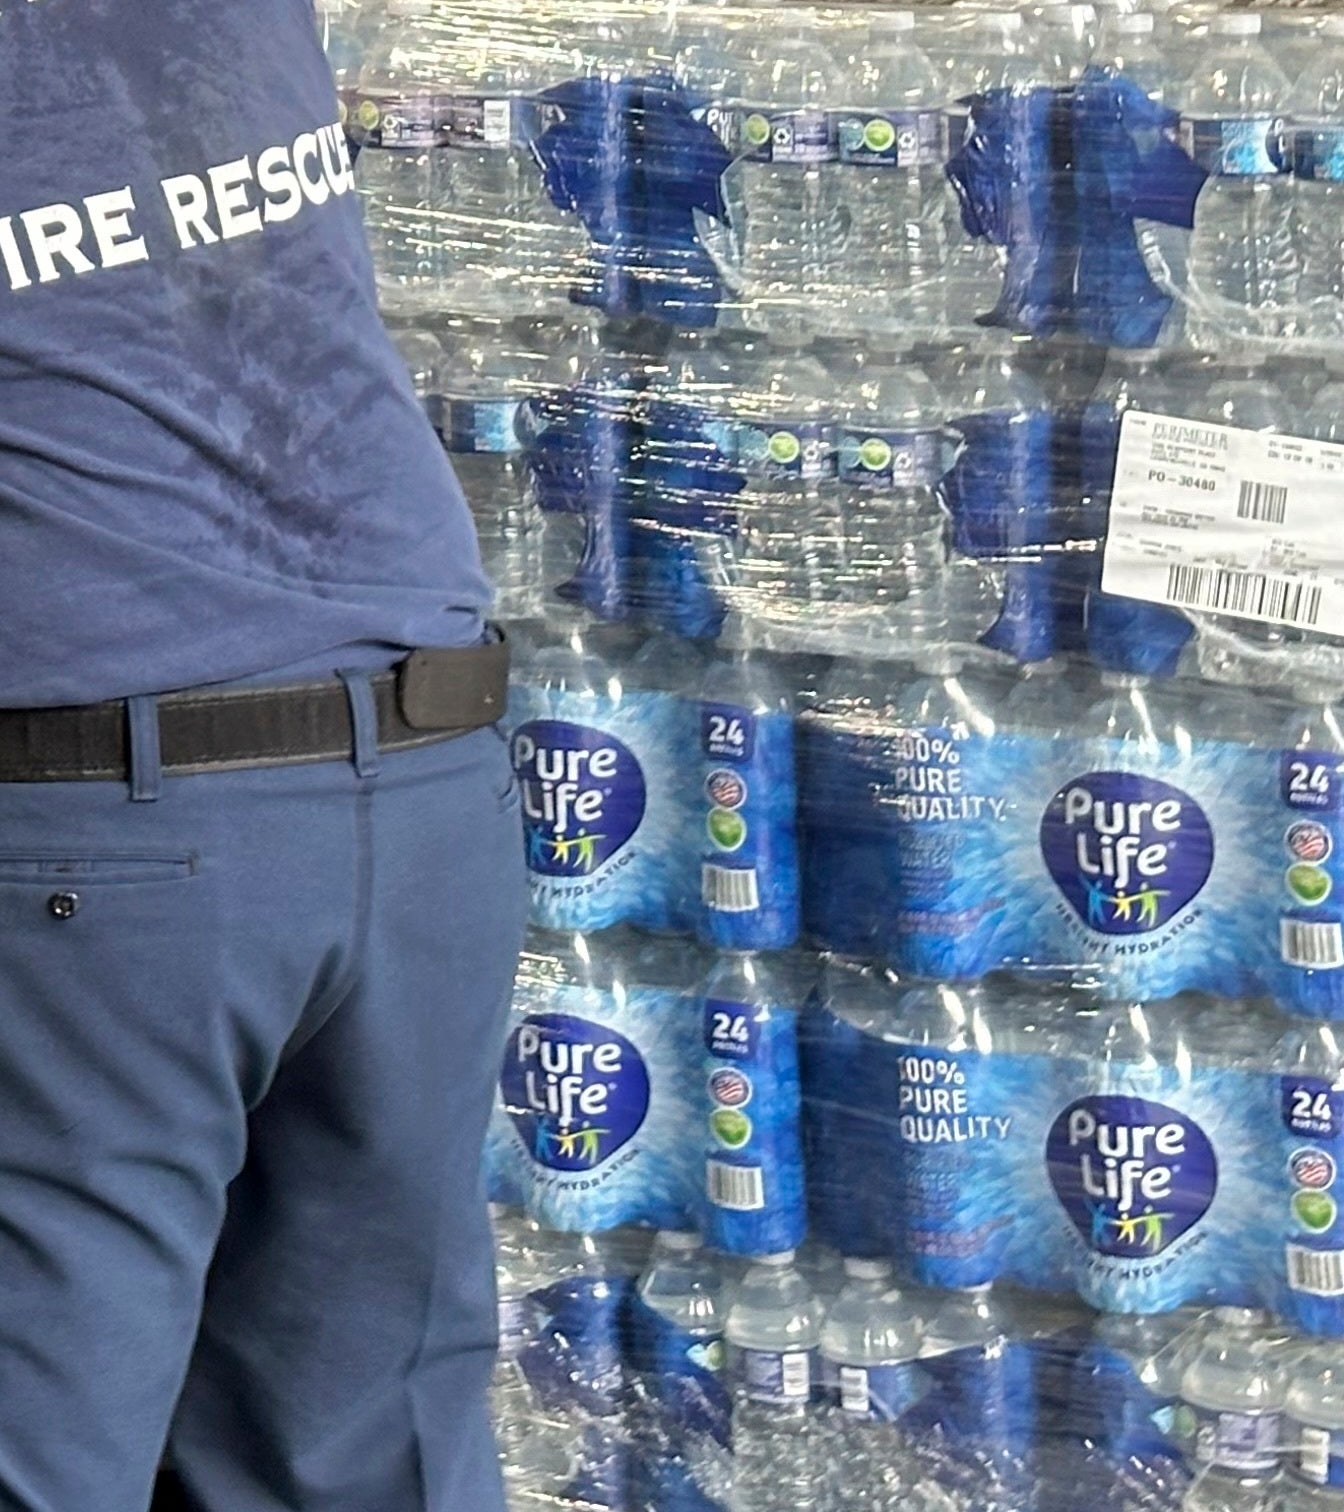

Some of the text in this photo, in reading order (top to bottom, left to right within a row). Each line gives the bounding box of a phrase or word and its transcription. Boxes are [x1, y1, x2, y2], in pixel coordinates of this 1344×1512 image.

[161, 122, 355, 249] RESCUE
[709, 716, 745, 745] 24
[514, 734, 618, 779] Pure
[1291, 762, 1330, 793] 24
[895, 767, 963, 793] PURE
[523, 784, 603, 832] Life
[1064, 787, 1182, 836] Pure
[1076, 833, 1170, 888] Life
[713, 1012, 749, 1042] 24
[518, 1025, 622, 1075] Pure
[899, 1056, 966, 1085] 100%
[526, 1070, 609, 1126] Life
[899, 1086, 968, 1114] PURE
[1292, 1091, 1332, 1120] 24
[900, 1116, 1012, 1144] QUALITY
[1069, 1108, 1186, 1158] Pure
[1080, 1154, 1173, 1211] Life
